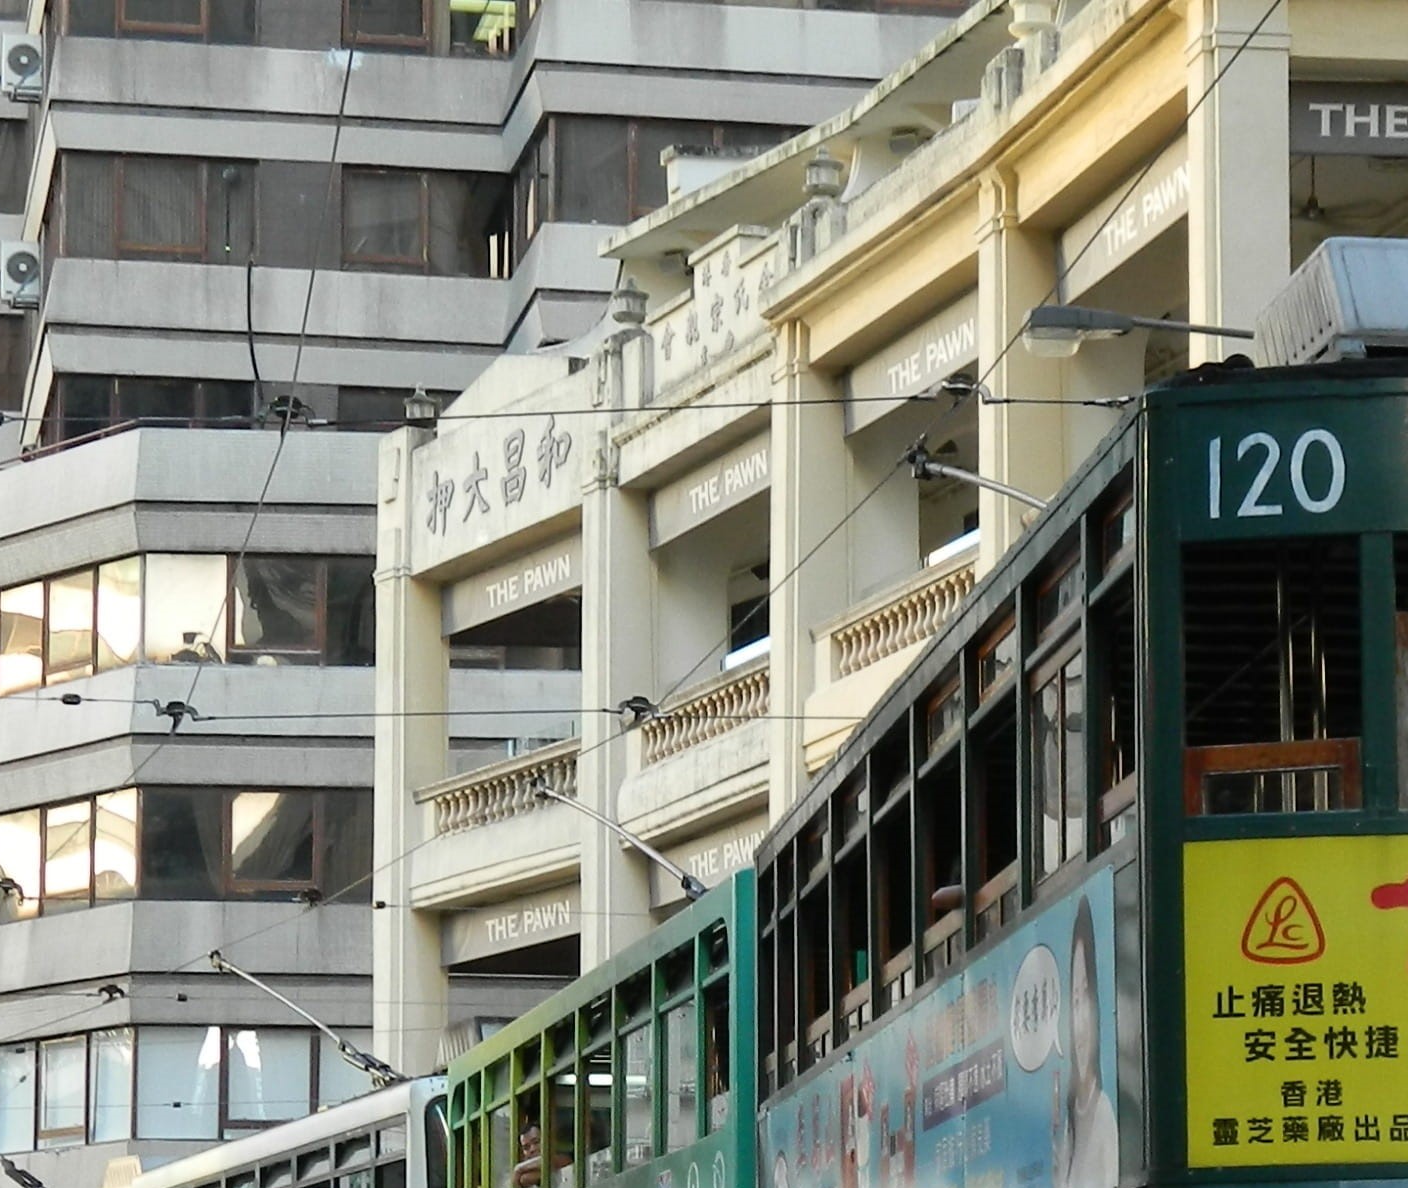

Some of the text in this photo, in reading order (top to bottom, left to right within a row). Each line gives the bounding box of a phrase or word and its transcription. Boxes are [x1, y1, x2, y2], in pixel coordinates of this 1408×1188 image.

[1103, 159, 1191, 257] THE PAWN
[888, 318, 975, 394] THE PAWN
[689, 450, 768, 514] THE PAWN
[1209, 428, 1346, 520] 120
[486, 554, 571, 608] THE PAWN
[690, 848, 720, 878] THE
[485, 900, 571, 943] THE PAWN
[1212, 981, 1367, 1018] 止痛退熱
[1244, 1025, 1399, 1063] 安全快捷
[1281, 1079, 1343, 1107] 香港
